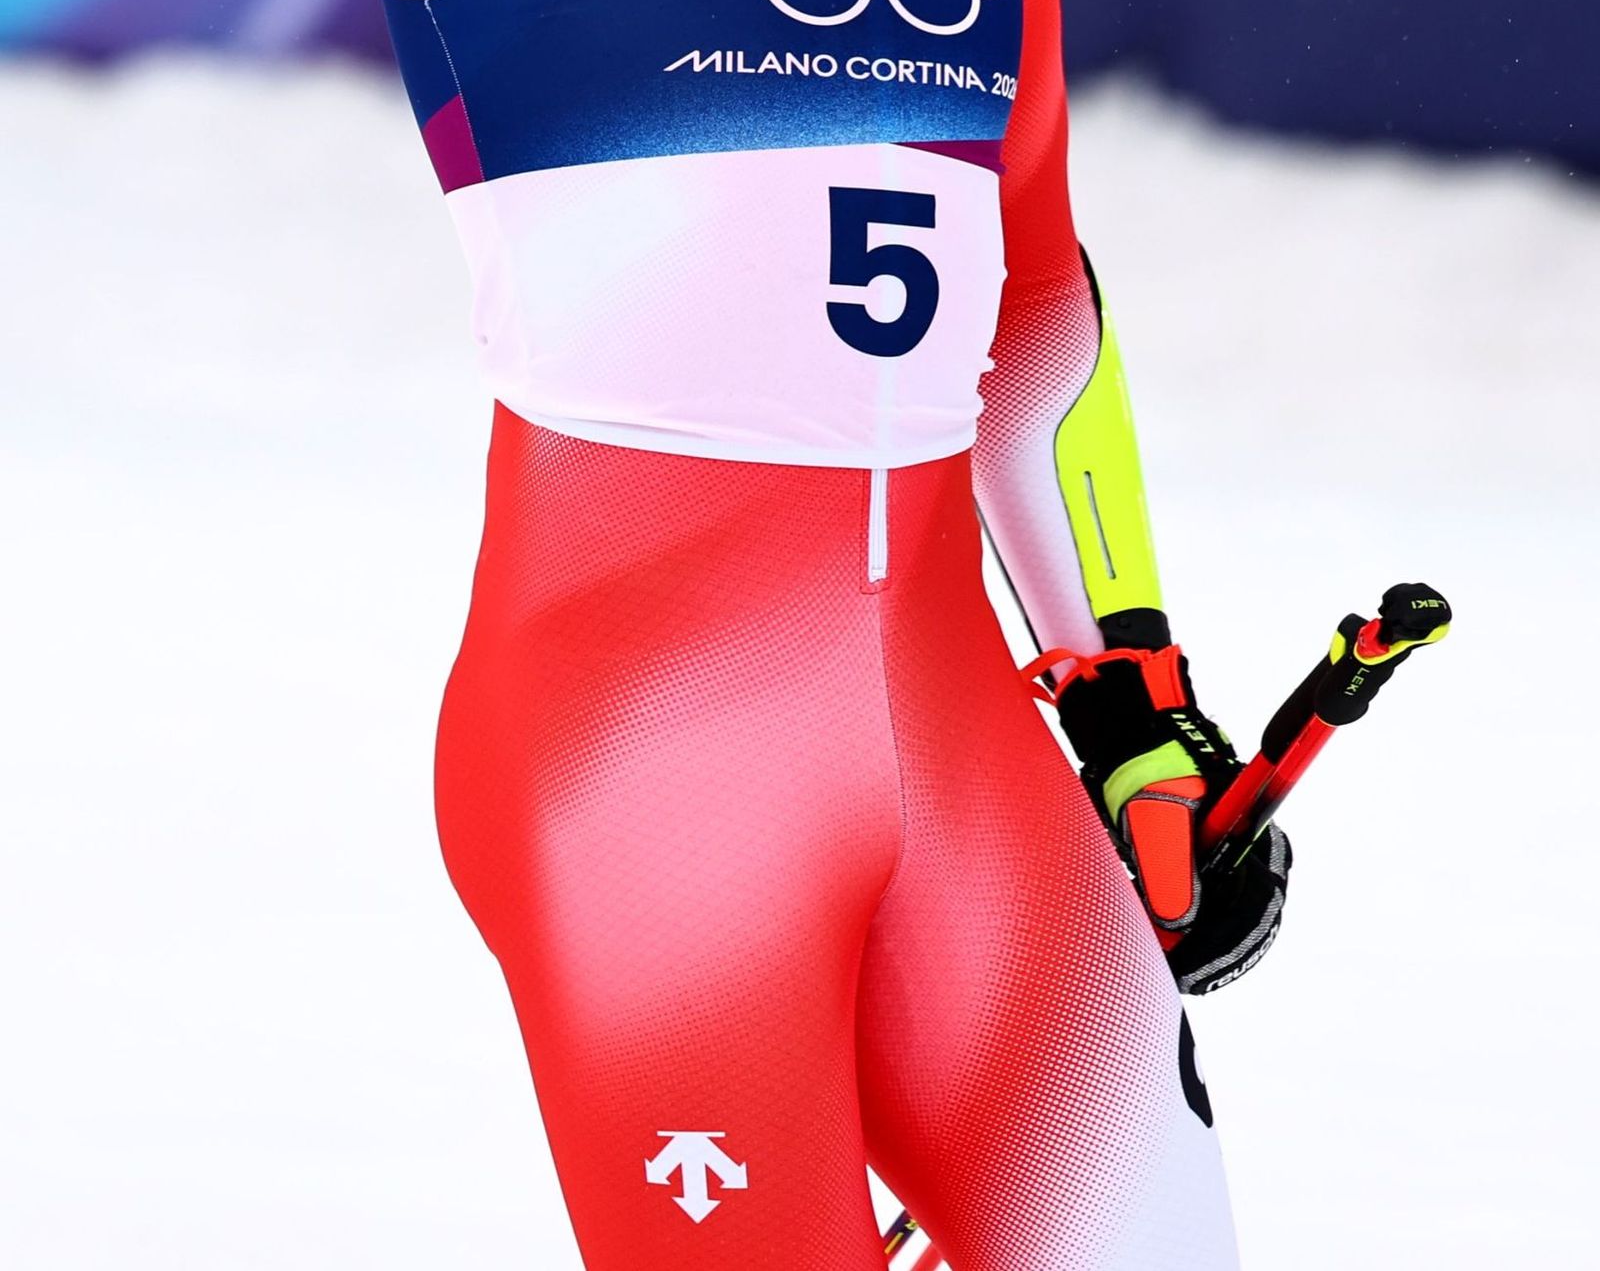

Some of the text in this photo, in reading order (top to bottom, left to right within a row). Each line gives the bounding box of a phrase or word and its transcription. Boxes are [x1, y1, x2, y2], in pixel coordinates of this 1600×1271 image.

[663, 49, 1018, 101] MILANO CORTINA 202
[826, 186, 940, 358] 5
[1411, 598, 1448, 610] LEKI
[1344, 667, 1371, 696] LEKI
[1171, 713, 1216, 753] LEKI
